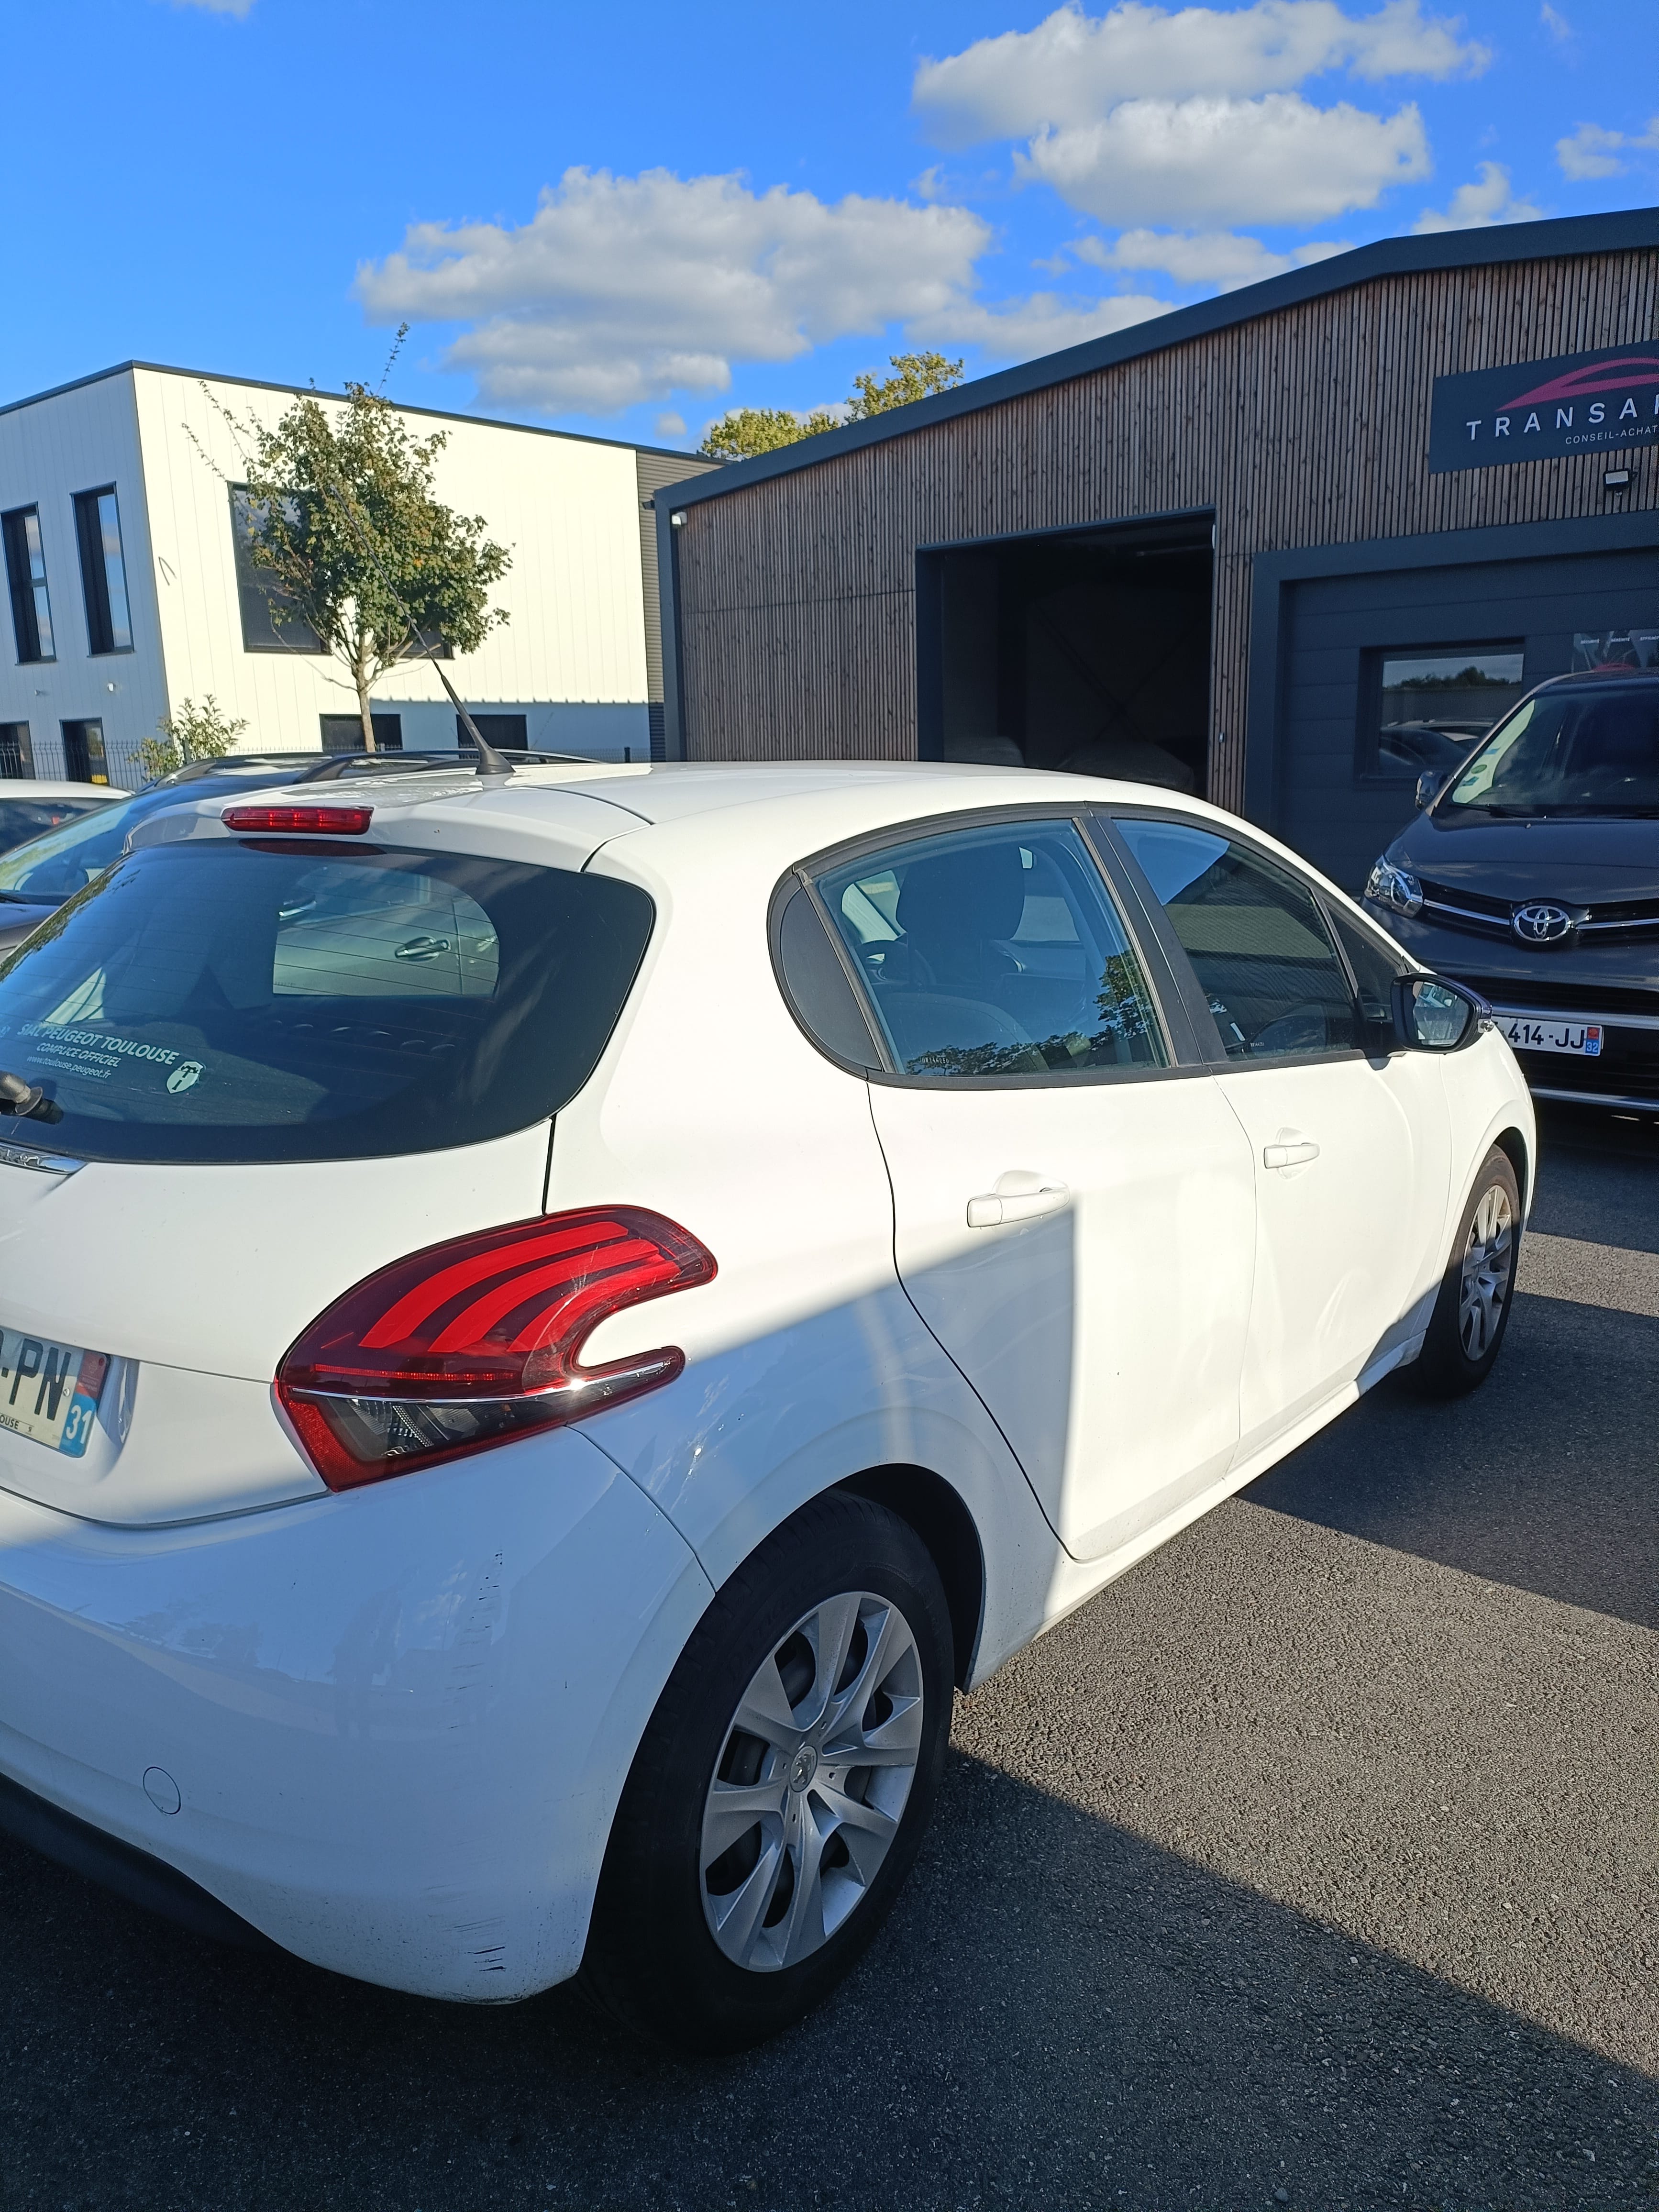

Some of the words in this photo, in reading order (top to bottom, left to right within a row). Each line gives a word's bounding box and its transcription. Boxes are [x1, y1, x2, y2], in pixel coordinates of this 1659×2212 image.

[41, 1026, 103, 1047] PEUGEOT
[100, 1036, 180, 1065] TOULOUSE
[1493, 1021, 1585, 1049] 414-JJ
[1586, 1042, 1599, 1052] 32
[27, 1056, 111, 1079] www.toulouse.peugeot.fr
[36, 1042, 81, 1058] COMPLICE
[78, 1051, 122, 1067] OFFICIEL
[66, 1405, 92, 1444] 31
